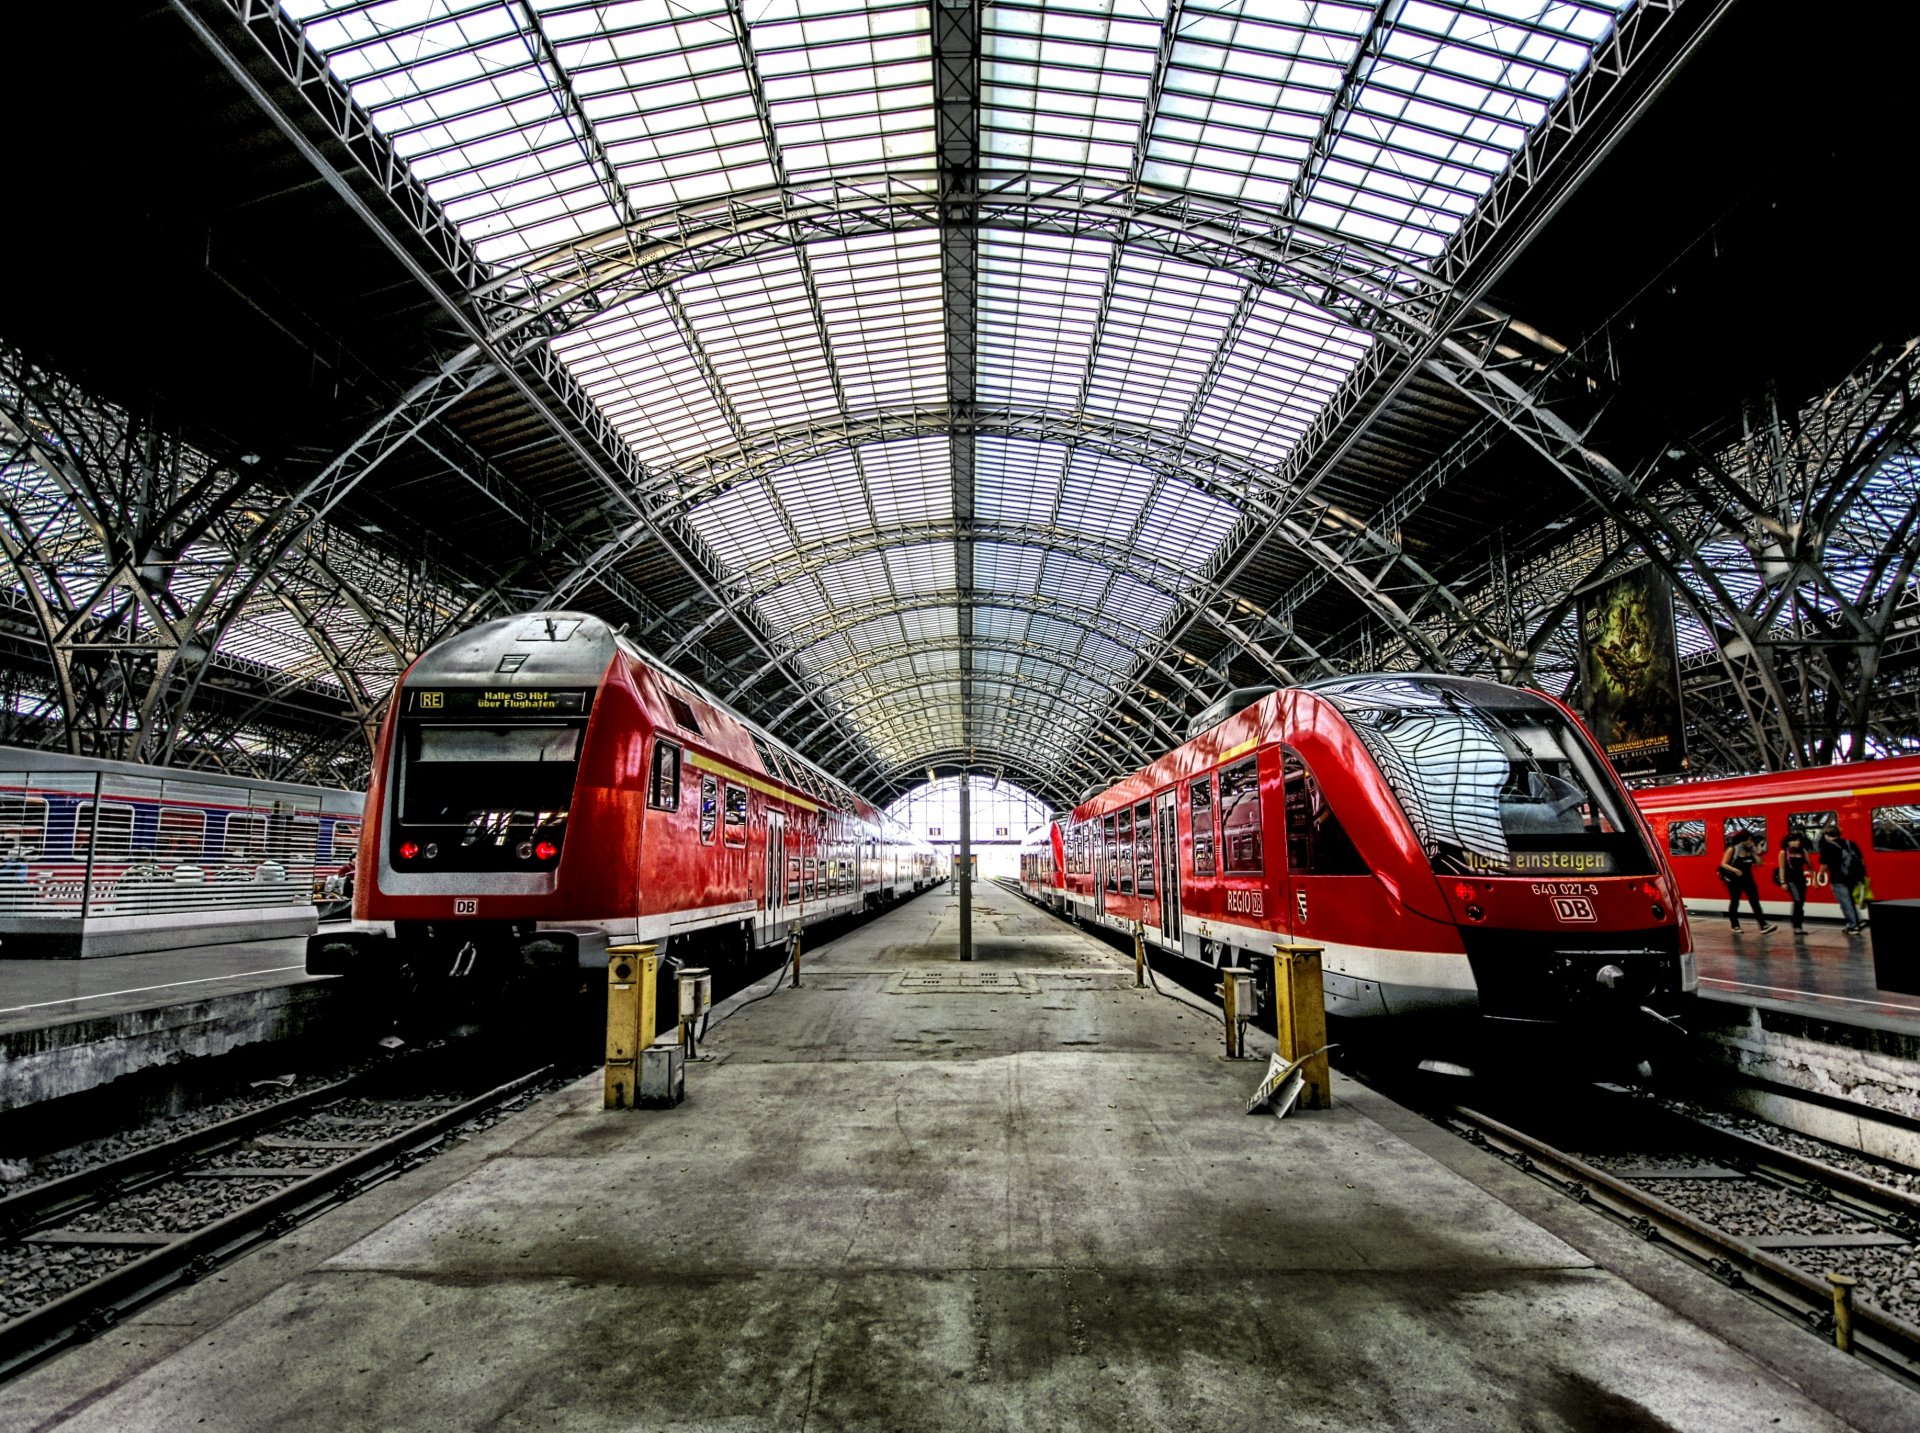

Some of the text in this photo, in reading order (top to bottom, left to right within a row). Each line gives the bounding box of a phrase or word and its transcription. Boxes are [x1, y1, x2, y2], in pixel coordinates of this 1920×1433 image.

[423, 693, 441, 707] RE
[484, 692, 548, 700] Halle (S) Hbf
[478, 699, 555, 708] über Flughafen
[1644, 735, 1670, 747] ONLINE
[1631, 747, 1670, 757] RECKONING
[1515, 851, 1605, 871] einsteigen
[1531, 883, 1599, 895] 640 027-9
[456, 900, 477, 914] DB
[1227, 890, 1263, 914] REGIO DB
[1554, 899, 1594, 919] DB
